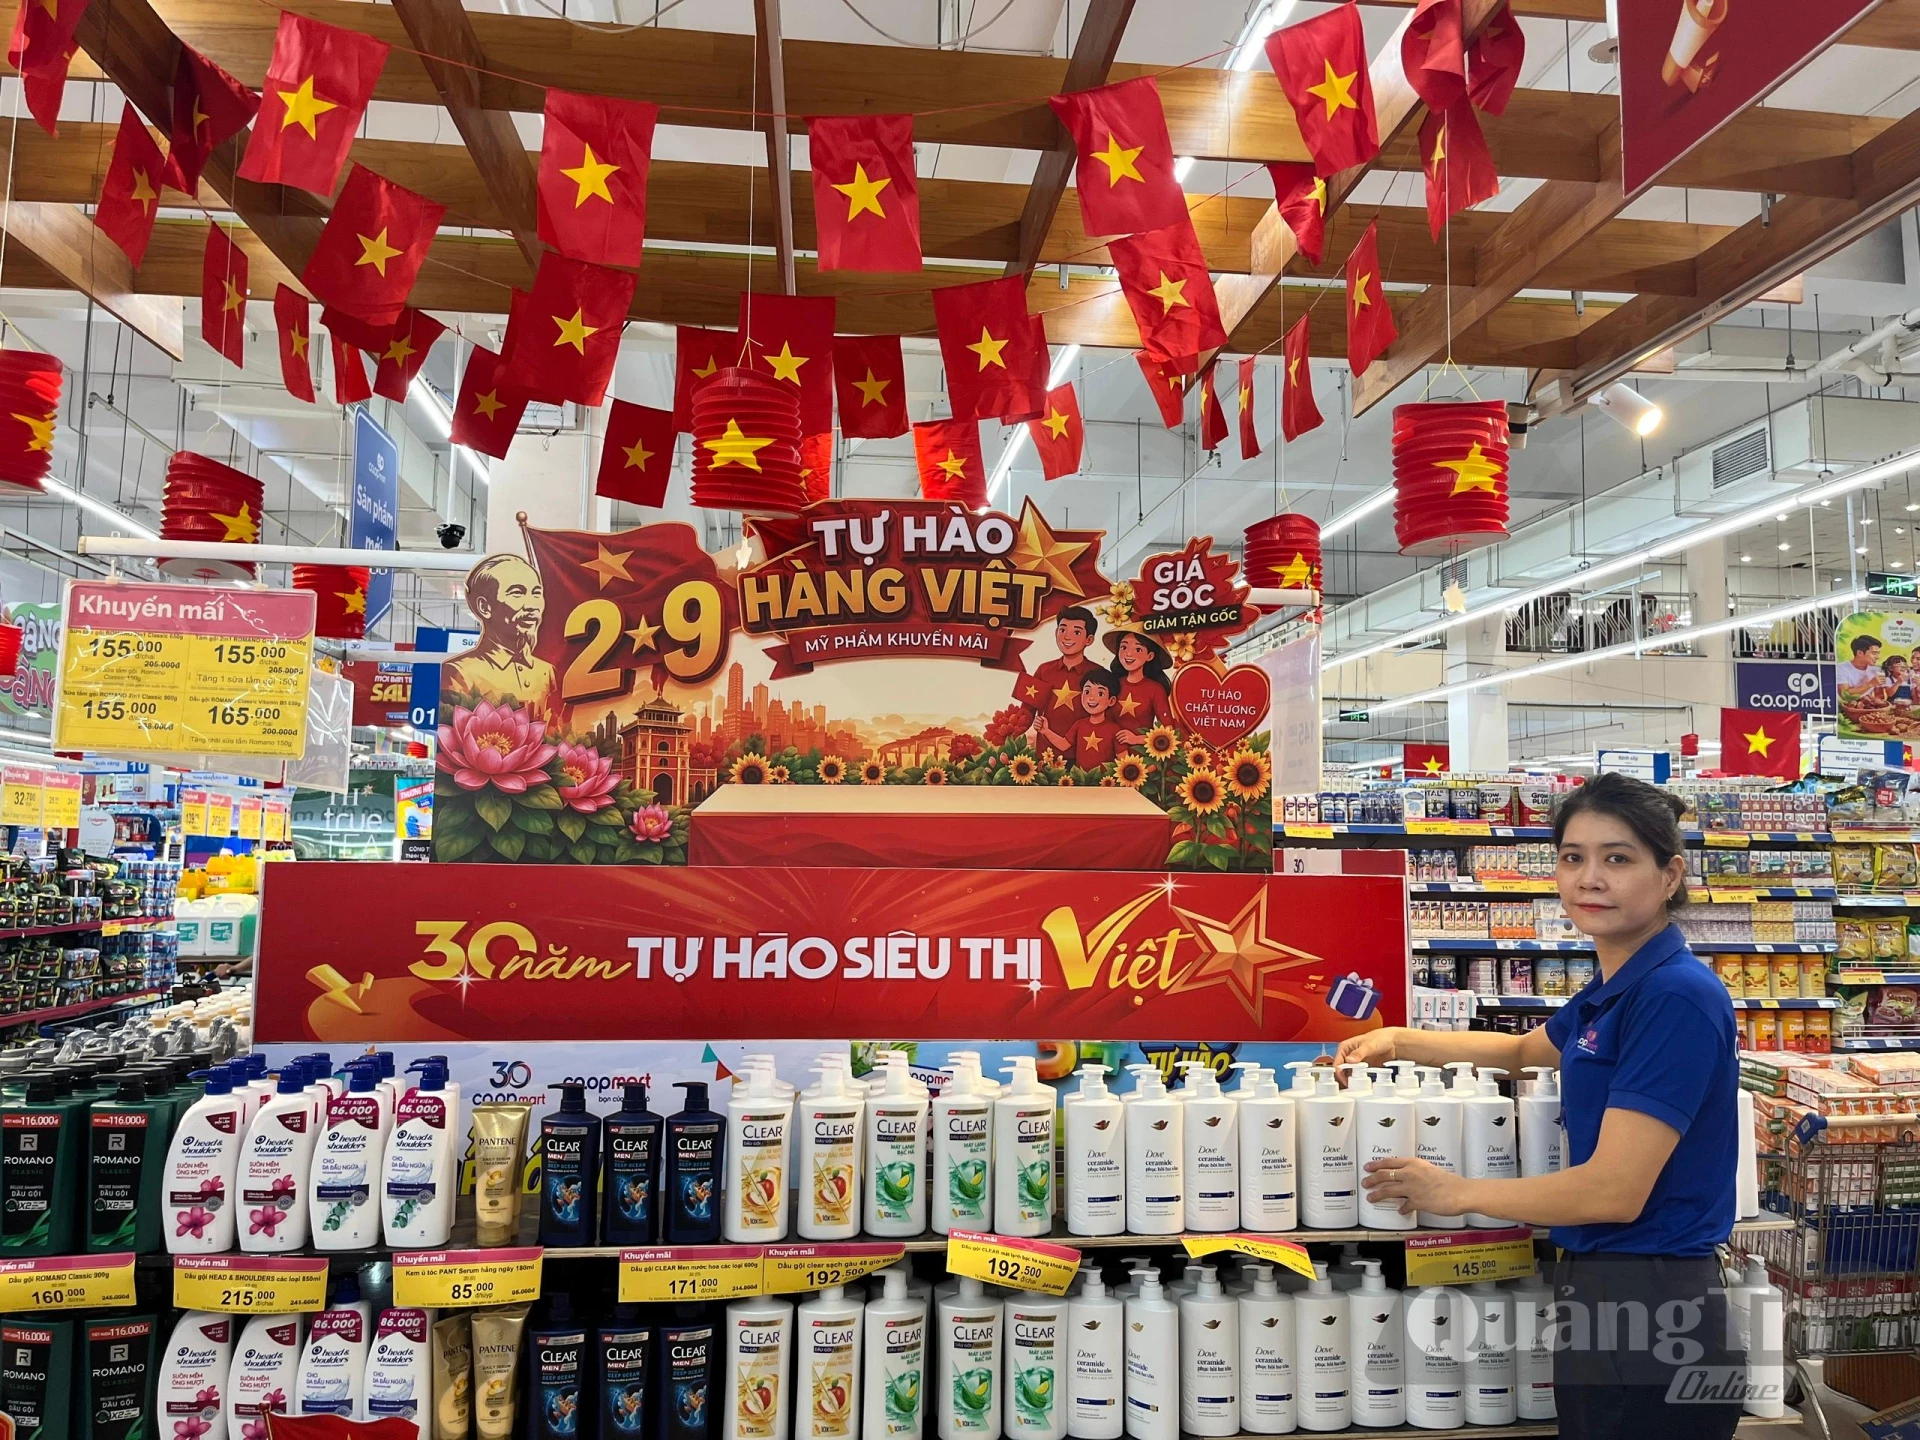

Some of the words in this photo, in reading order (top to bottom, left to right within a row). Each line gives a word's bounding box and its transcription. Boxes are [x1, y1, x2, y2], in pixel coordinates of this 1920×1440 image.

[812, 509, 890, 565] TỰ
[903, 505, 1013, 554] HÀO
[1154, 554, 1205, 584] GIÁ
[743, 559, 906, 623] HÀNG
[921, 559, 1047, 627] VIỆT
[1152, 580, 1215, 611] SỐC
[78, 595, 172, 621] Khuyến
[179, 601, 224, 621] mãi
[1144, 615, 1177, 631] GIẢM
[1181, 612, 1206, 629] TẬN
[1210, 608, 1237, 623] GỐC
[89, 638, 162, 658] 155.000
[805, 634, 830, 652] MỸ
[835, 628, 883, 649] PHẨM
[887, 629, 953, 647] KHUYẾN
[959, 632, 989, 650] MÃI
[215, 645, 286, 664] 155.000
[1201, 688, 1216, 700] TỰ
[1218, 689, 1242, 700] HÀO
[83, 700, 156, 720] 155.000
[208, 706, 280, 725] 165.000
[412, 707, 436, 725] 01
[1185, 700, 1215, 713] CHẤT
[1218, 705, 1256, 716] LƯỢNG
[1193, 716, 1217, 728] VIỆT
[1220, 719, 1245, 728] NAM
[324, 808, 383, 830] true
[407, 920, 538, 981] 30
[499, 943, 633, 981] năm
[627, 936, 704, 984] TỰ
[843, 930, 952, 979] SIÊU
[960, 937, 1042, 995] THỊ
[1041, 884, 1195, 1006] Việt
[489, 1061, 532, 1089] 30
[479, 1137, 516, 1146] PANTENE
[547, 1139, 581, 1152] CLEAR
[613, 1138, 648, 1151] CLEAR
[677, 1138, 712, 1150] CLEAR
[181, 1146, 222, 1154] shoulders
[1088, 1150, 1107, 1158] Dove
[1145, 1149, 1164, 1158] Dove
[93, 1156, 140, 1164] ROMANO
[28, 1190, 41, 1198] GỘI
[953, 1231, 982, 1241] Khuyến
[983, 1235, 997, 1243] mãi
[1409, 1238, 1437, 1247] Khuyến
[397, 1254, 428, 1264] Khuyến
[429, 1254, 446, 1262] mãi
[624, 1251, 655, 1261] Khuyến
[768, 1247, 798, 1257] Khuyến
[178, 1258, 210, 1268] Khuyến
[988, 1257, 1041, 1281] 192.500
[1453, 1260, 1496, 1277] 145.000
[235, 1274, 274, 1282] SHOULDERS
[806, 1268, 864, 1286] 192.500
[452, 1282, 493, 1299] 85.000
[668, 1278, 718, 1294] 171.000
[32, 1288, 85, 1304] 160.000
[221, 1290, 275, 1306] 215.000
[479, 1344, 516, 1354] PANTENE
[3, 1370, 45, 1380] ROMANO
